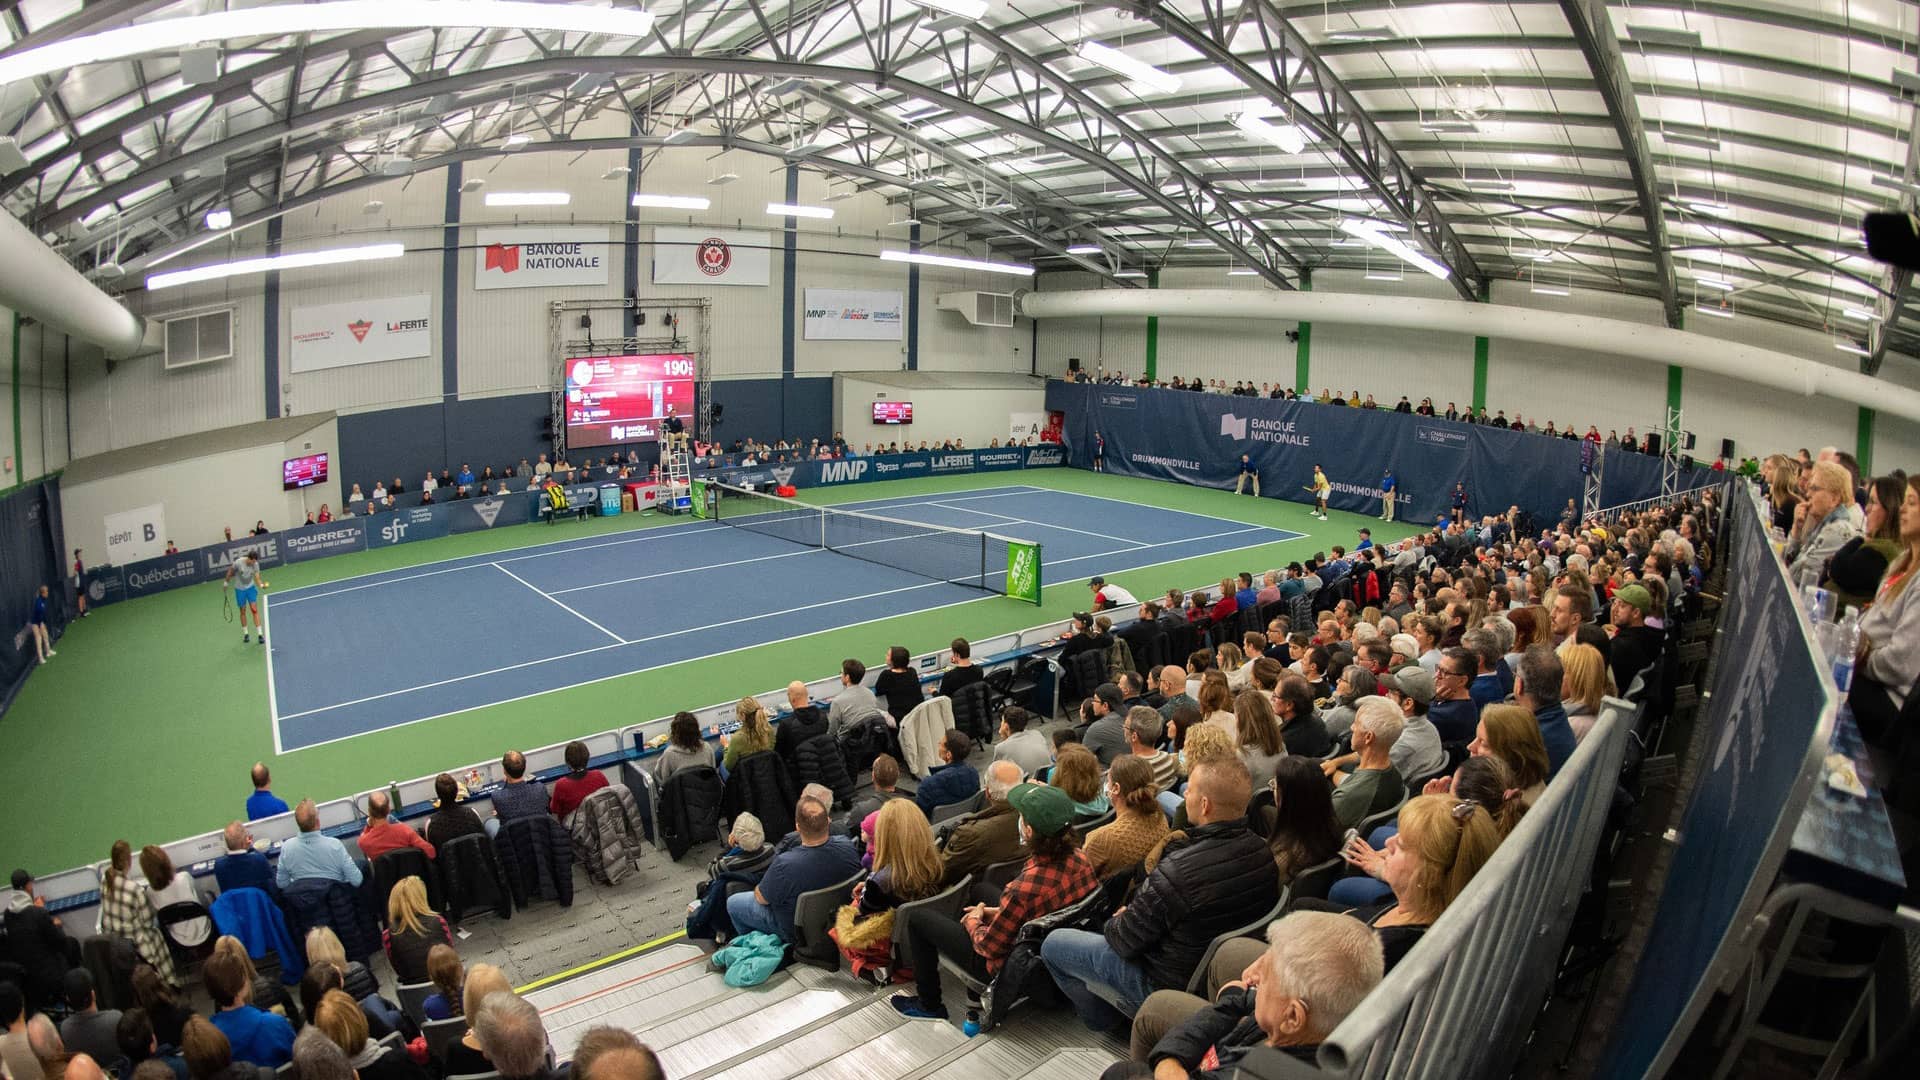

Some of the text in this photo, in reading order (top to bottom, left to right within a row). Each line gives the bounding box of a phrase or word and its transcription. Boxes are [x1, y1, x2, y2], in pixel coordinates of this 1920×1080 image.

[526, 243, 581, 255] BANQUE
[526, 256, 600, 269] NATIONALE
[806, 310, 826, 319] MNP
[664, 360, 688, 376] 190
[1031, 423, 1039, 435] A
[1251, 418, 1296, 433] BANQUE
[1251, 430, 1310, 447] NATIONALE
[1430, 430, 1466, 441] CHALLENGER
[1132, 453, 1200, 470] DRUMMONDVILLE
[821, 460, 868, 483] MNP
[1329, 481, 1412, 504] DRUMMONDLE
[109, 523, 156, 546] DÉPÔT B
[382, 518, 408, 543] sfr
[129, 567, 177, 589] Québec
